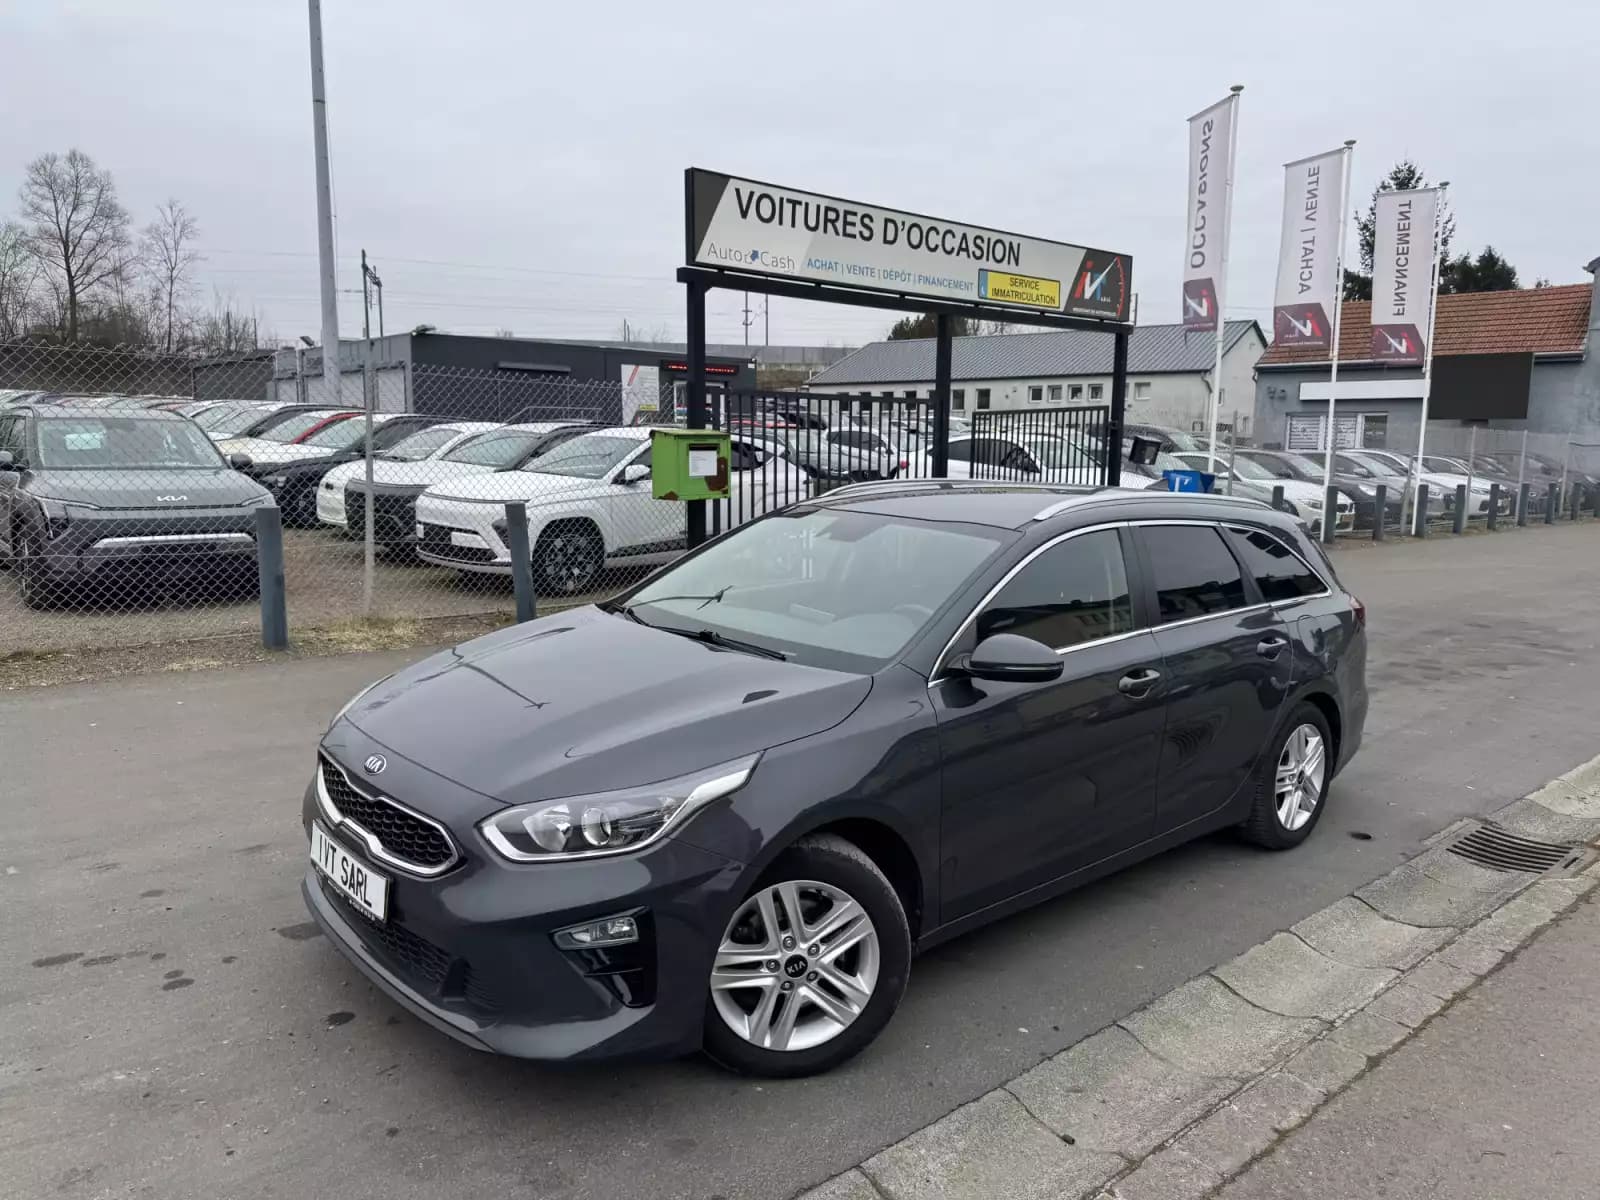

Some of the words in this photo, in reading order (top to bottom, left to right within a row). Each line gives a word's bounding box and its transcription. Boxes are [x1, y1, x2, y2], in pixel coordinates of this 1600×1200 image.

[735, 187, 874, 241] VOITURES
[707, 242, 743, 262] Auto
[760, 251, 796, 270] Cash
[807, 257, 839, 273] ACHAT
[846, 263, 876, 278] VENTE
[882, 267, 912, 282] DÉPÔT
[918, 273, 974, 293] FINANCEMENT
[1009, 276, 1040, 291] SERVICE
[991, 287, 1056, 305] IMMATRICULATION
[364, 755, 383, 773] KIA
[318, 833, 337, 875] IVT
[340, 855, 373, 908] SARL
[786, 960, 806, 974] KIA
